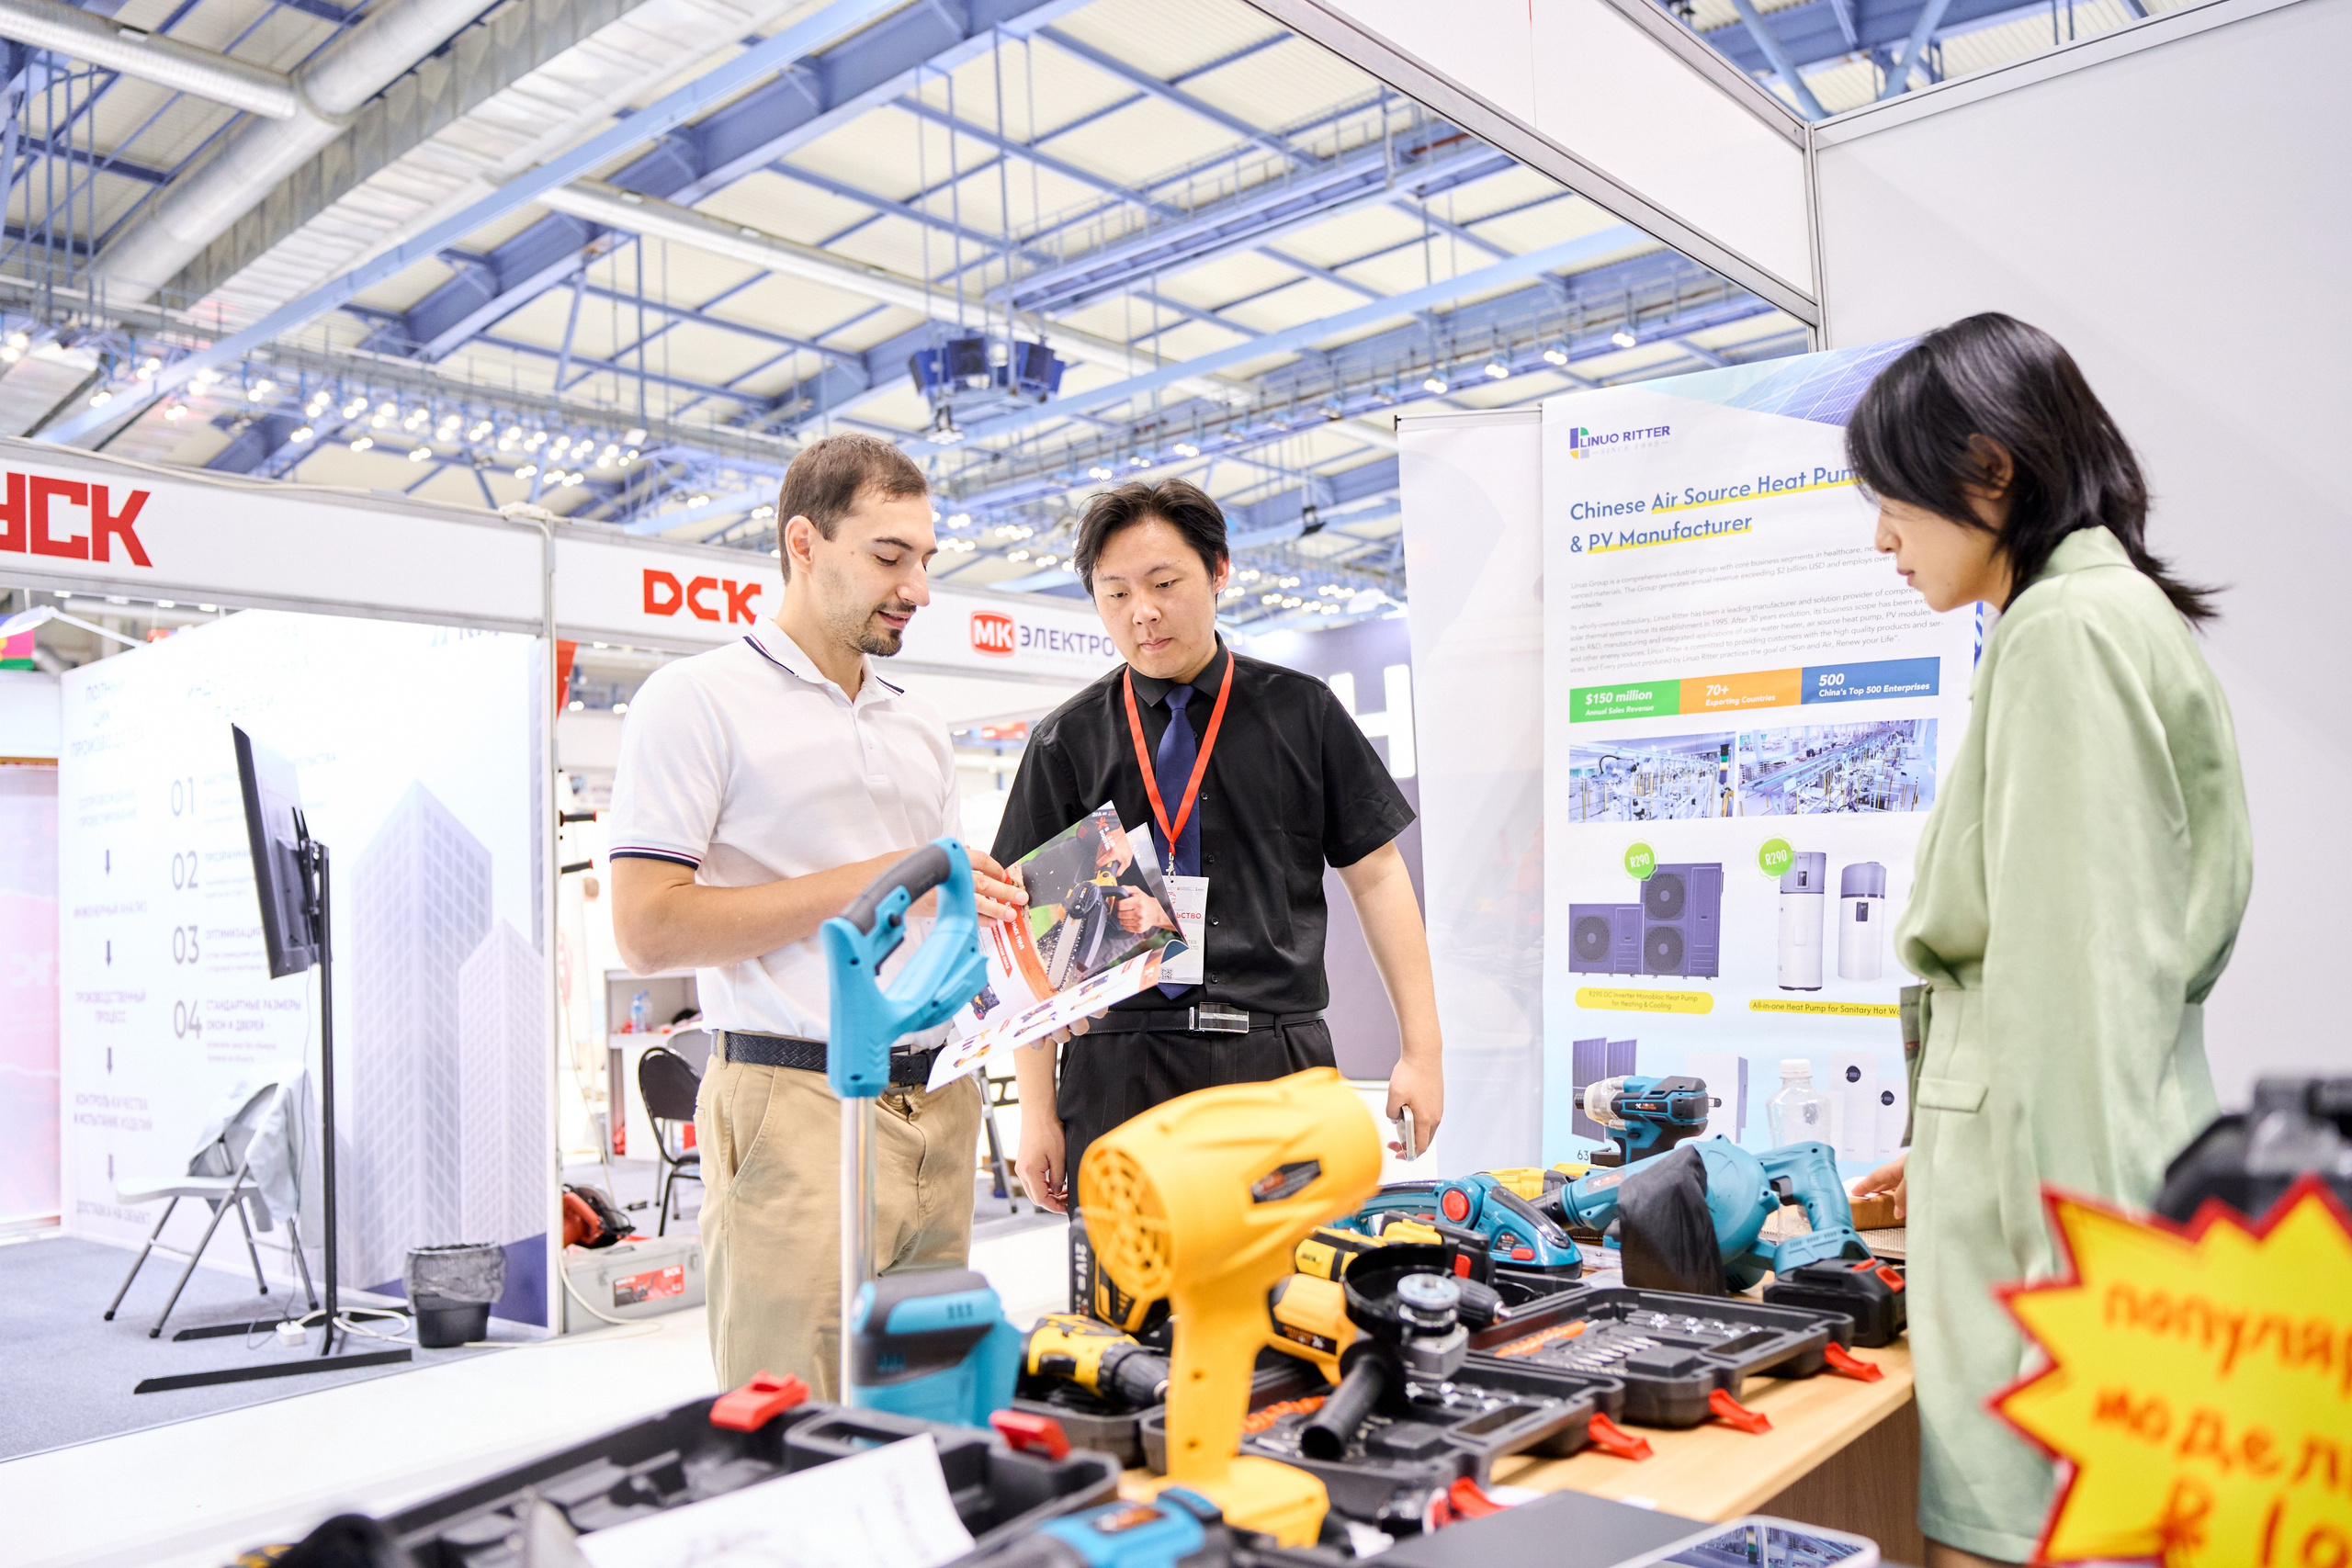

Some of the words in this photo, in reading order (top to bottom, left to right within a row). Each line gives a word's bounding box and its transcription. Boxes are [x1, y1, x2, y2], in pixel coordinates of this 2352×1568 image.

[1580, 434, 1619, 448] LINUO
[1623, 425, 1670, 442] RITTER
[1634, 441, 1660, 450] 1995
[1570, 500, 1645, 520] Chinese
[1651, 492, 1678, 511] Air
[1684, 484, 1751, 505] Source
[1758, 471, 1806, 494] Heat
[1570, 536, 1582, 553] &
[1589, 532, 1613, 551] PV
[1620, 517, 1752, 547] Manufacturer
[643, 569, 762, 626] DCK
[1752, 597, 1796, 610] manufacturer
[1842, 589, 1872, 603] provider
[1885, 610, 1896, 618] PV
[1898, 605, 1932, 617] modules
[1876, 620, 1910, 634] products
[1912, 618, 1927, 628] and
[1020, 626, 1114, 658] ЭЛЕКТРО
[1818, 673, 1845, 687] 500
[1585, 691, 1613, 705] $150
[1616, 689, 1653, 703] million
[1706, 684, 1729, 696] 70+
[1819, 688, 1847, 697] China's
[1849, 687, 1864, 696] Top
[1866, 684, 1882, 694] 500
[1883, 682, 1930, 693] Enterprises
[1706, 696, 1739, 706] Exporting
[1741, 694, 1776, 704] Countries
[1586, 707, 1607, 716] Annual
[1608, 705, 1624, 715] Sales
[1626, 705, 1654, 713] Revenue
[171, 776, 194, 817] 01
[1630, 852, 1650, 869] R290
[1765, 849, 1788, 866] R290
[172, 850, 198, 890] 02
[173, 925, 199, 964] 03
[1621, 1000, 1643, 1009] Heating
[1649, 1001, 1671, 1010] Cooling
[1752, 1001, 1784, 1010] All-in-one
[1786, 1003, 1804, 1011] Heat
[1805, 1004, 1826, 1013] Pump
[1827, 1004, 1838, 1013] for
[1840, 1005, 1871, 1016] Sanitary
[1873, 1007, 1886, 1015] Hot
[174, 999, 201, 1040] 04
[1577, 1150, 1589, 1161] 63
[1075, 1242, 1087, 1275] 21V
[2091, 1385, 2352, 1497] модел
